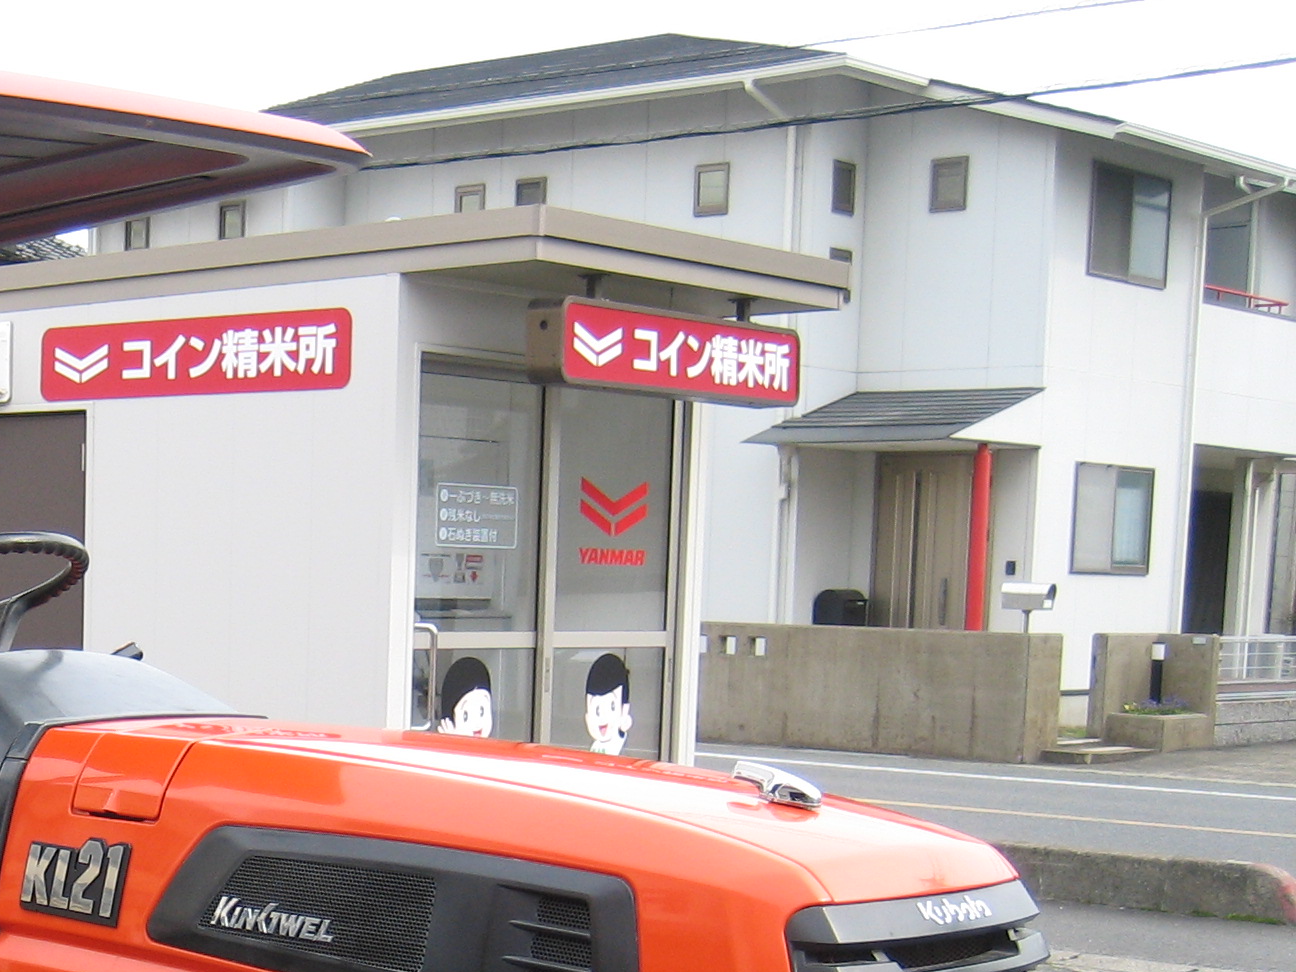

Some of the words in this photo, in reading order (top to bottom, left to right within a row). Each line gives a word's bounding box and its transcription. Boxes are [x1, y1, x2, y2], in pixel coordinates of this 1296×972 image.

[122, 323, 337, 379] コイン精米所
[633, 328, 791, 392] コイン精米所
[579, 547, 646, 566] YANMAR
[21, 840, 124, 917] KL21
[916, 895, 992, 925] Kubota
